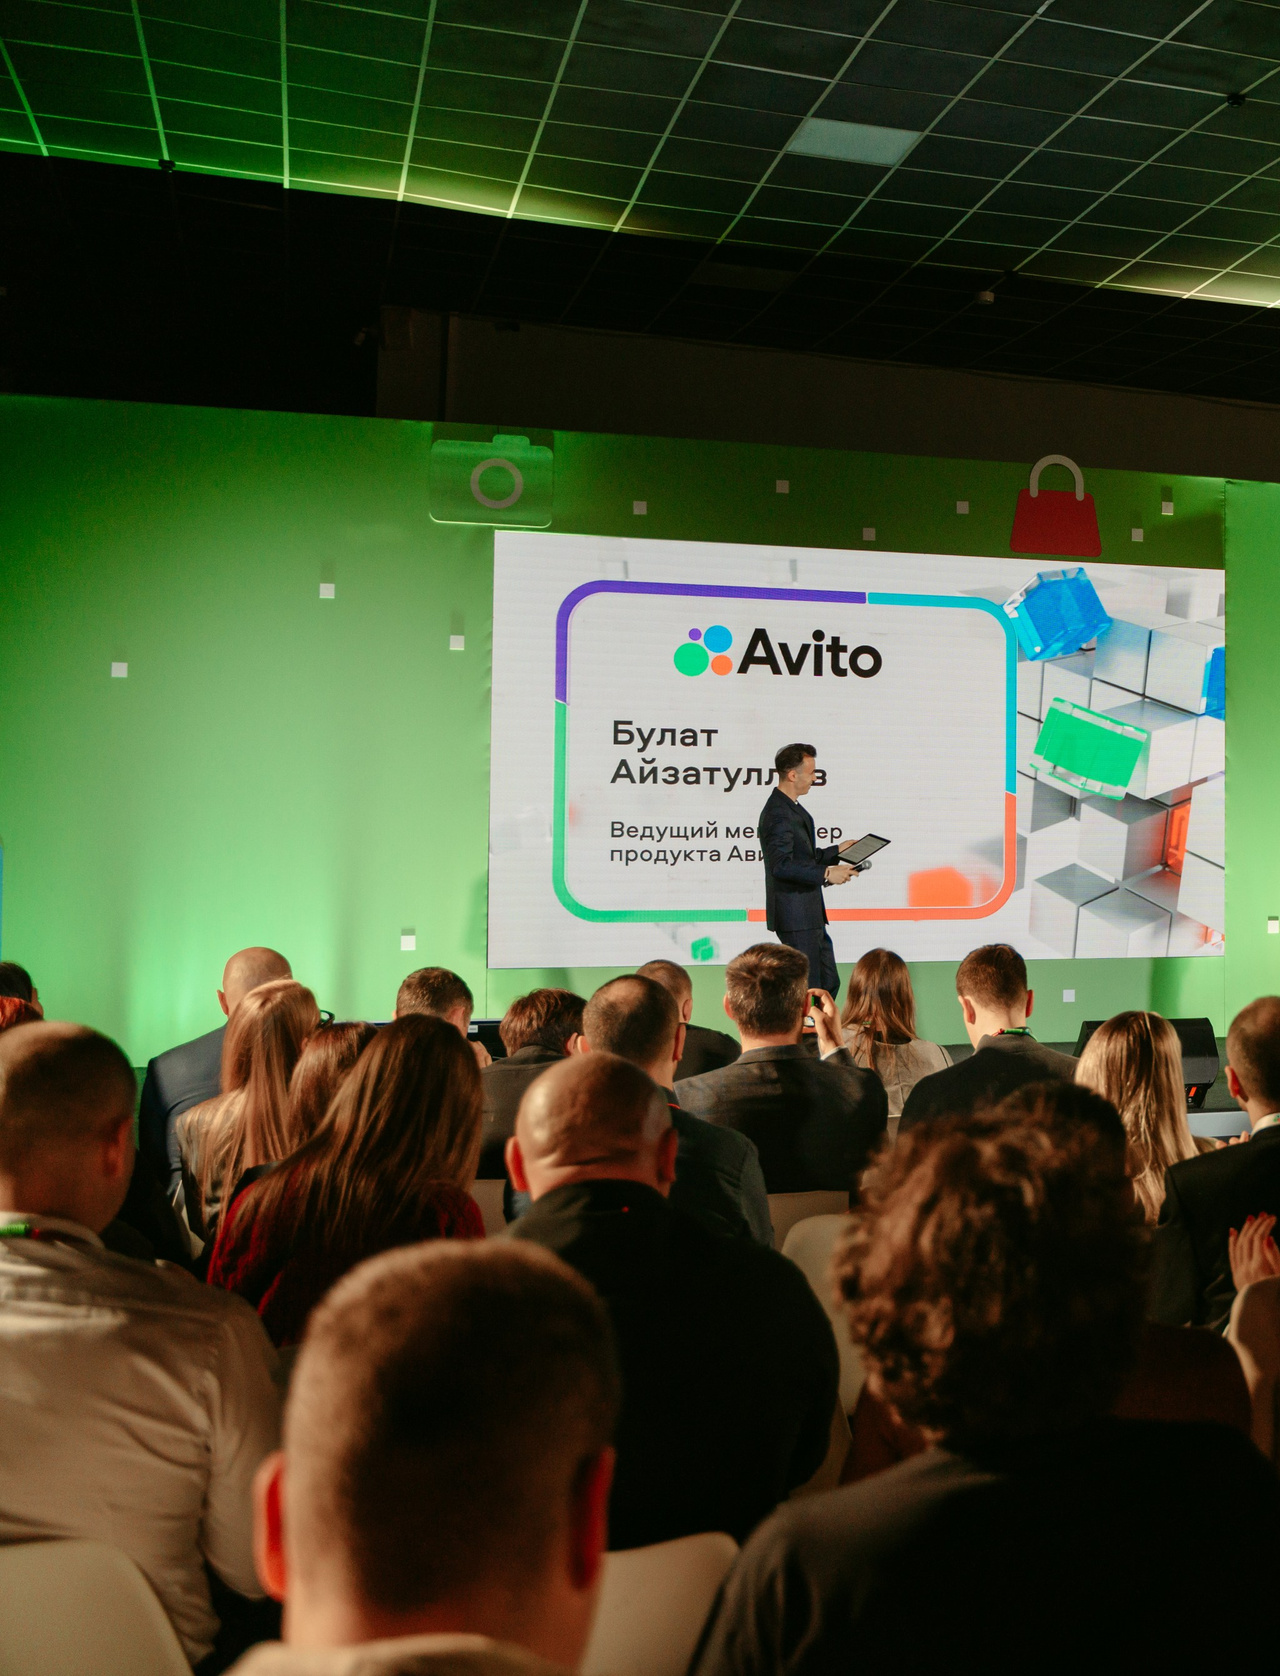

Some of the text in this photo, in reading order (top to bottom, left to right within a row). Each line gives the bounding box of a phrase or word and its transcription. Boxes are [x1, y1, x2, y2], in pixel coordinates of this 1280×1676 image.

[737, 627, 883, 679] Avito
[612, 719, 719, 753] Булат
[610, 757, 828, 793] Айзатуллв
[610, 820, 718, 843] Ведущий
[610, 848, 722, 867] продукта
